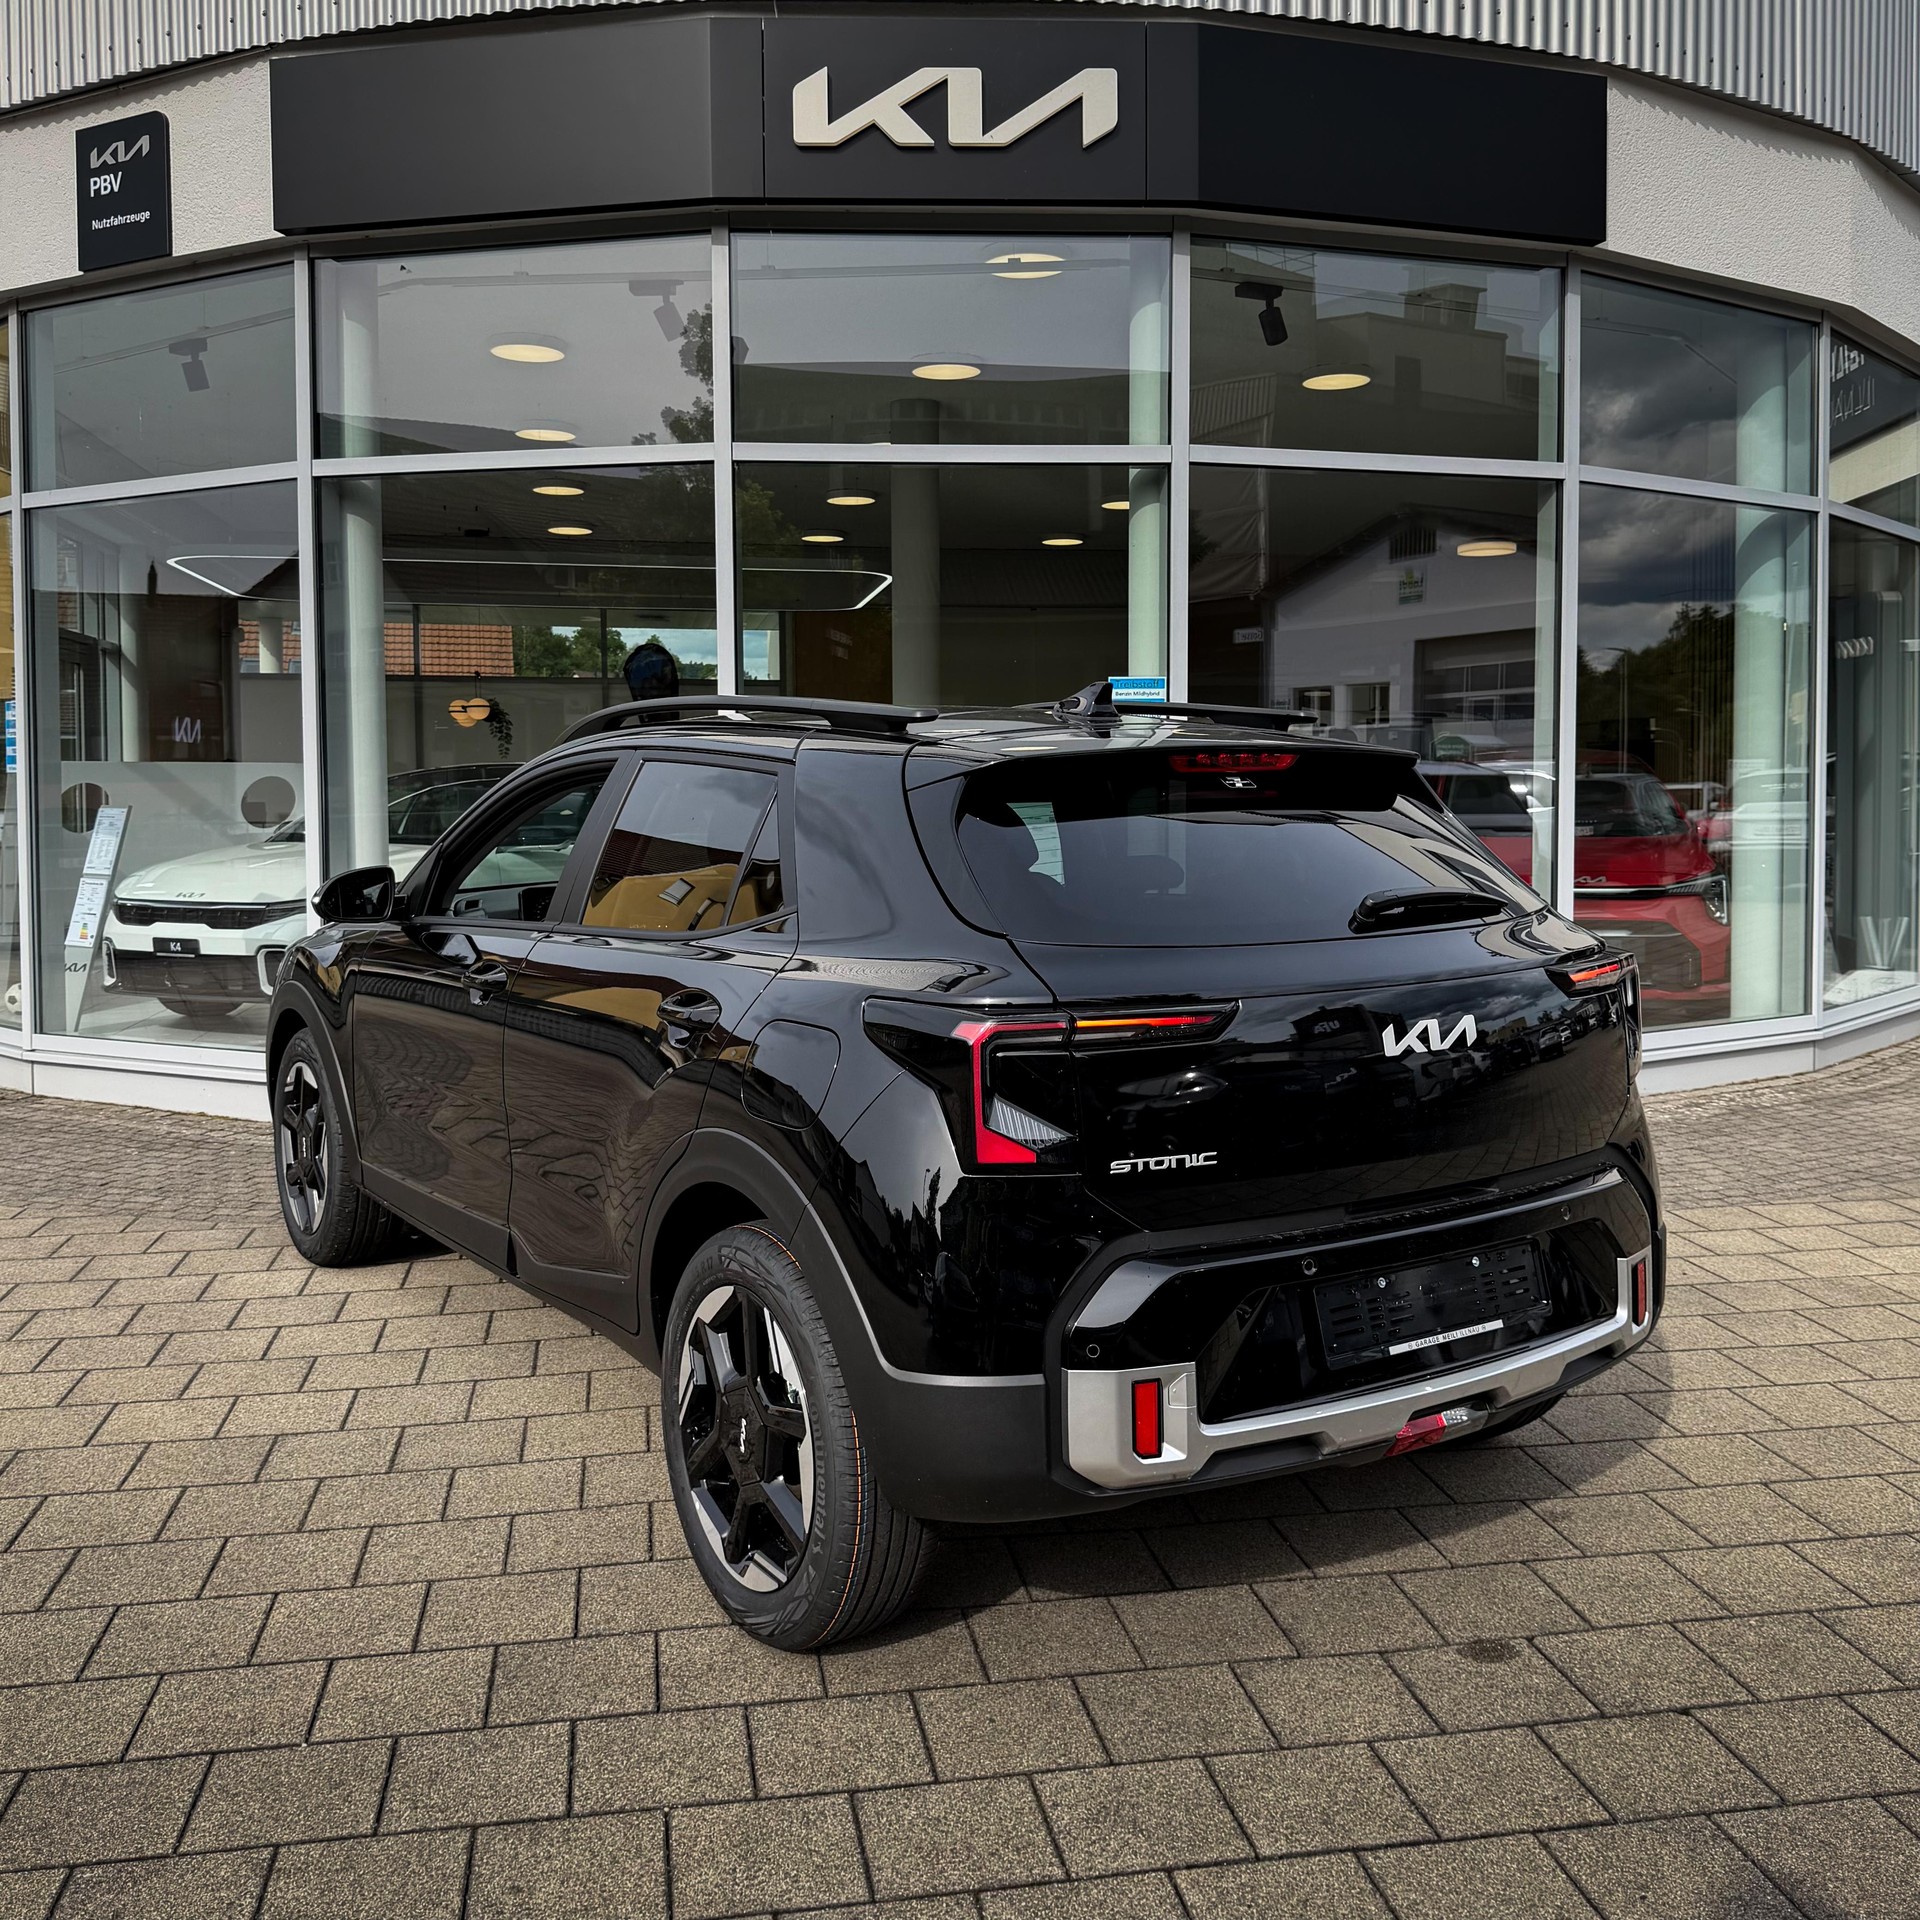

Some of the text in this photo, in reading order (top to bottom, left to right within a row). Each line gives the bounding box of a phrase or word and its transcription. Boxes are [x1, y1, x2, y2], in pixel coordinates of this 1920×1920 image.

[792, 66, 1118, 148] KIA
[90, 134, 150, 169] KIA
[90, 171, 122, 198] PBV
[91, 210, 151, 231] Nutzfahrzeuge
[1115, 680, 1160, 689] Treibstoff
[169, 941, 182, 952] K4
[1382, 1014, 1477, 1057] KIA
[1109, 1151, 1218, 1174] STONIC
[1414, 1327, 1480, 1348] GARAGE MEILI ILLNAU
